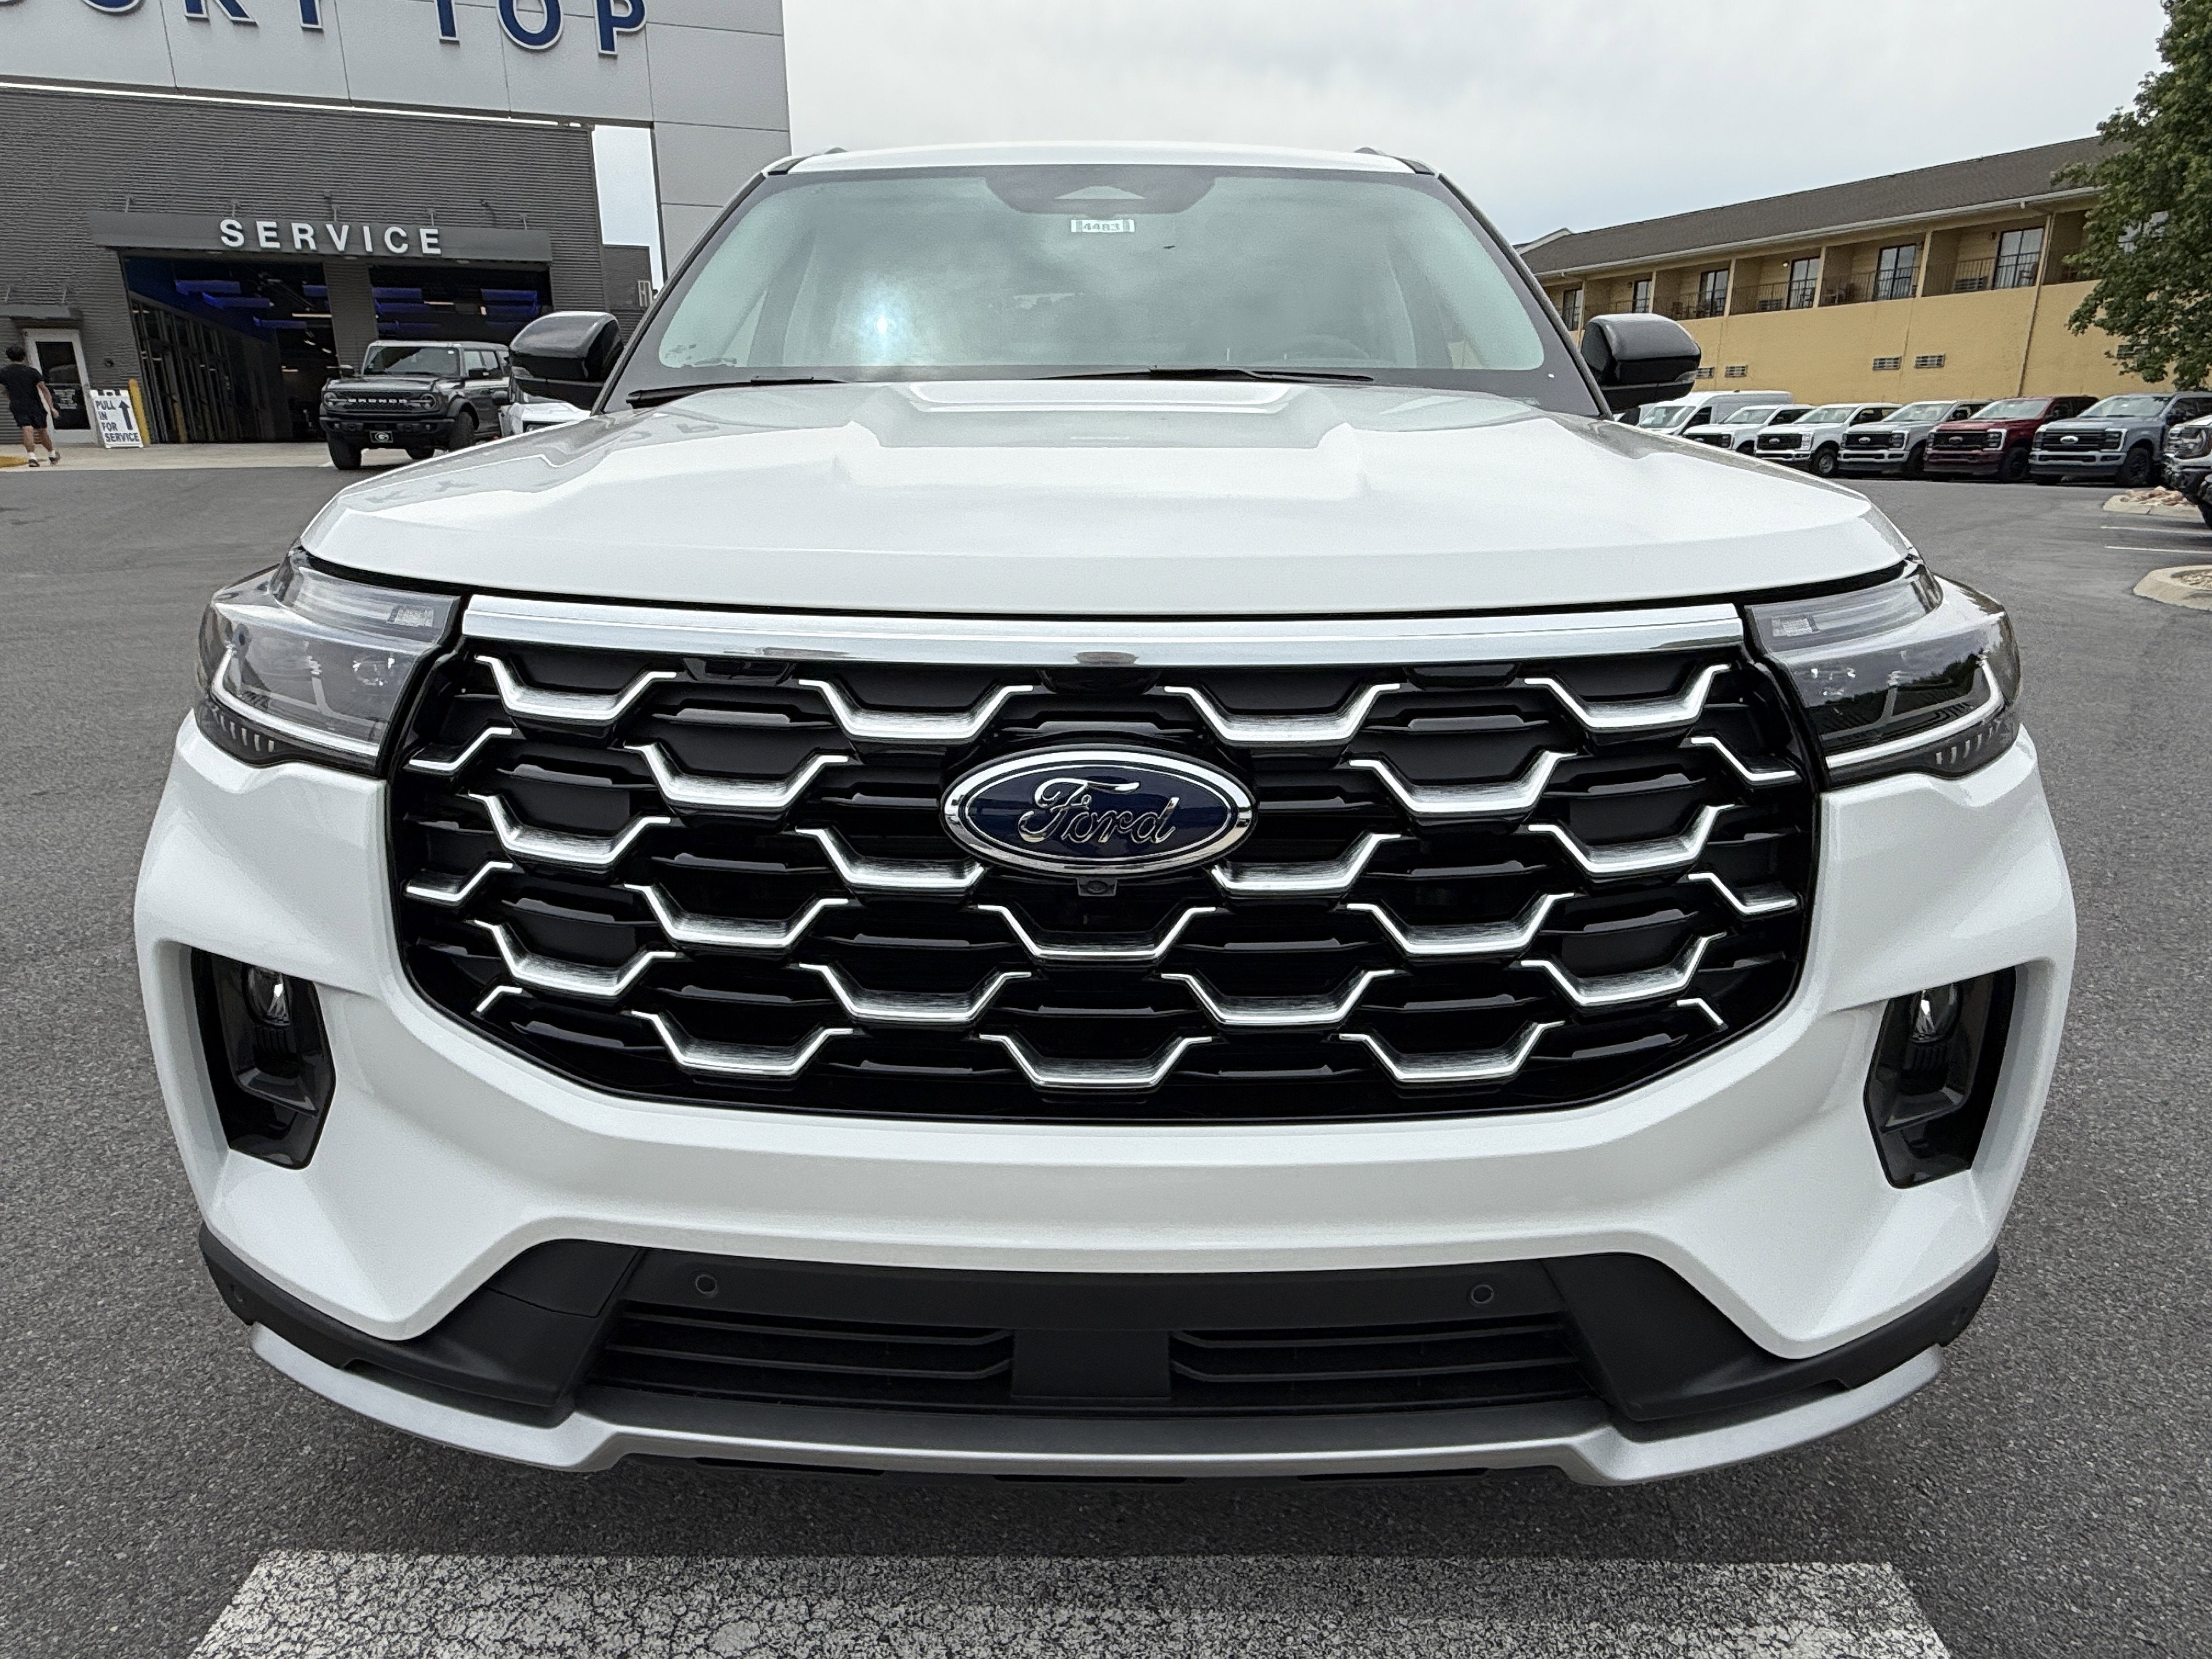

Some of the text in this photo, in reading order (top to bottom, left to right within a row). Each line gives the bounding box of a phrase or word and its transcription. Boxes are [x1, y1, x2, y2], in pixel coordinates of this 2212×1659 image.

[220, 219, 441, 254] SERVICE
[95, 400, 116, 410] PULL
[98, 411, 108, 420] IN
[101, 422, 118, 431] FOR
[105, 432, 139, 442] SERVICE
[1018, 777, 1180, 844] Ford
